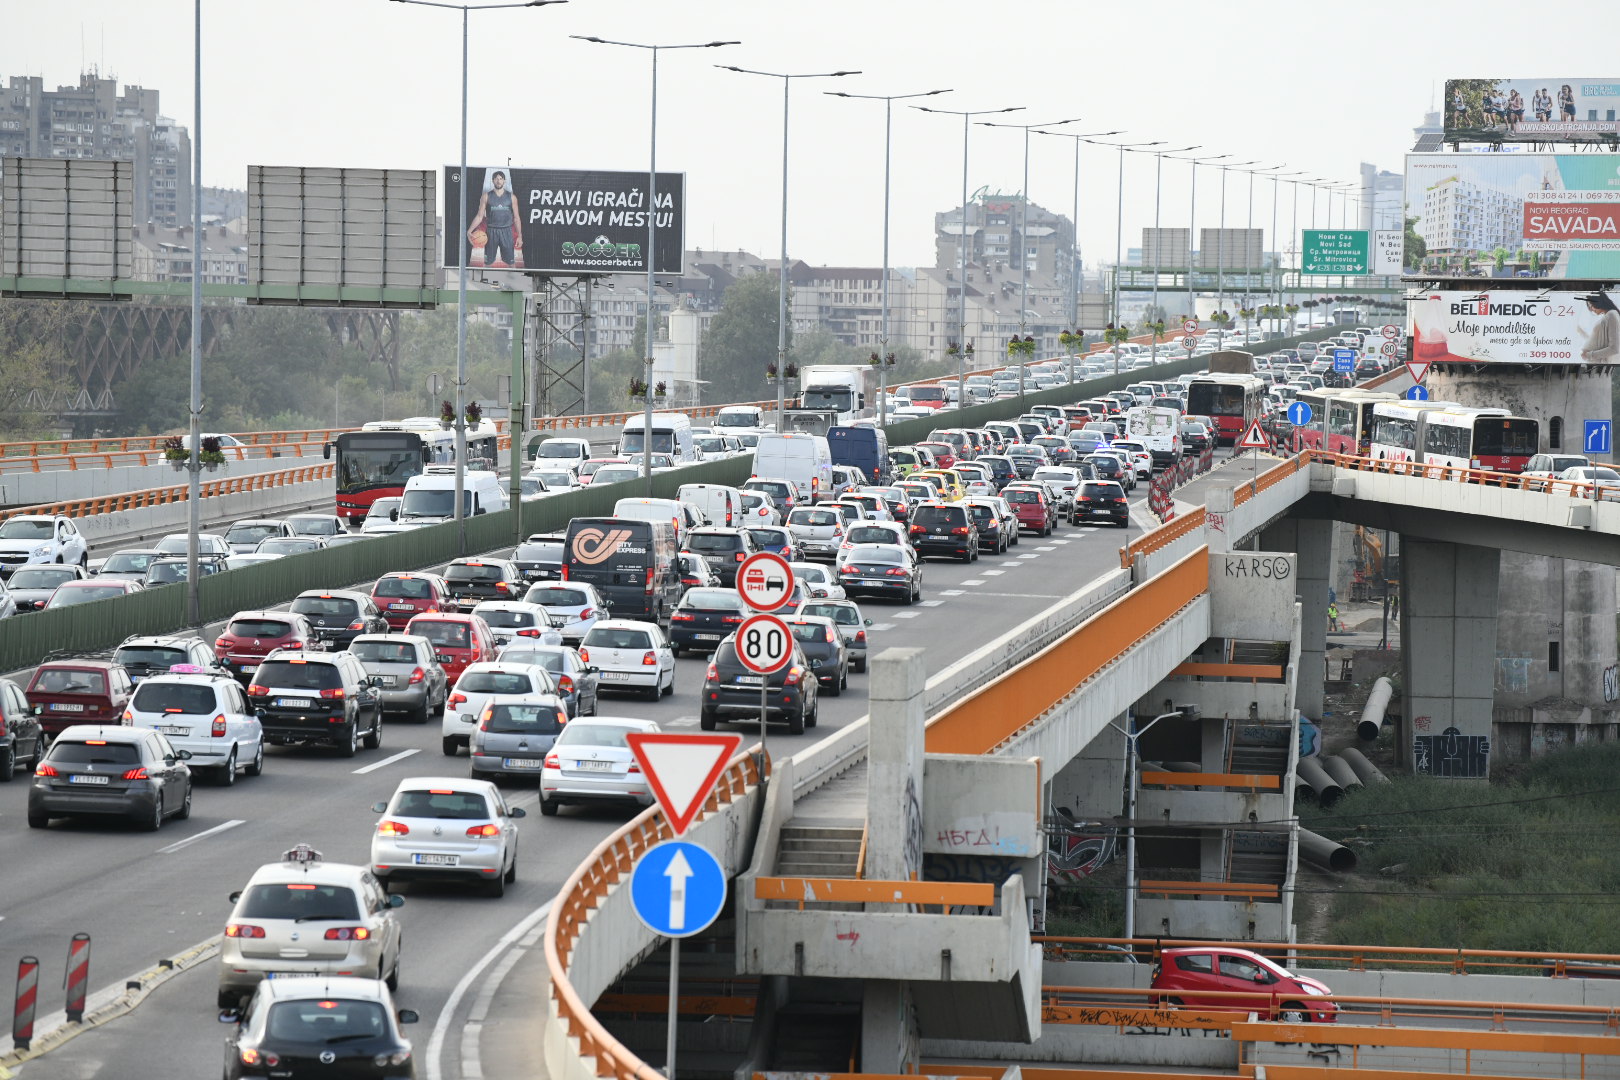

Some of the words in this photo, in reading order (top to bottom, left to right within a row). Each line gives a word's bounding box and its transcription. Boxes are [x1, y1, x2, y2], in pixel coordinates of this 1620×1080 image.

[529, 189, 582, 206] PRAVI
[587, 187, 644, 208] IGRAČI
[1541, 192, 1557, 200] 308
[1567, 192, 1577, 200] 24
[1586, 192, 1602, 200] 069
[1529, 207, 1549, 215] NOVI
[1550, 207, 1589, 215] BEOGRAD
[529, 208, 604, 226] PRAVOM
[608, 210, 674, 228] MESTU!
[1529, 216, 1617, 234] SAVADA
[561, 240, 642, 259] SOCCER
[562, 257, 643, 267] www.soccerbet.rs
[1450, 303, 1477, 316] BEL
[1489, 303, 1537, 317] MEDIC
[1543, 305, 1576, 317] 0-24
[1448, 320, 1480, 337] Moje
[1482, 321, 1536, 337] porodilište
[1184, 338, 1195, 347] 80
[1510, 336, 1522, 347] gde
[1384, 344, 1395, 354] 80
[1549, 351, 1571, 359] 1000
[746, 628, 782, 659] 80
